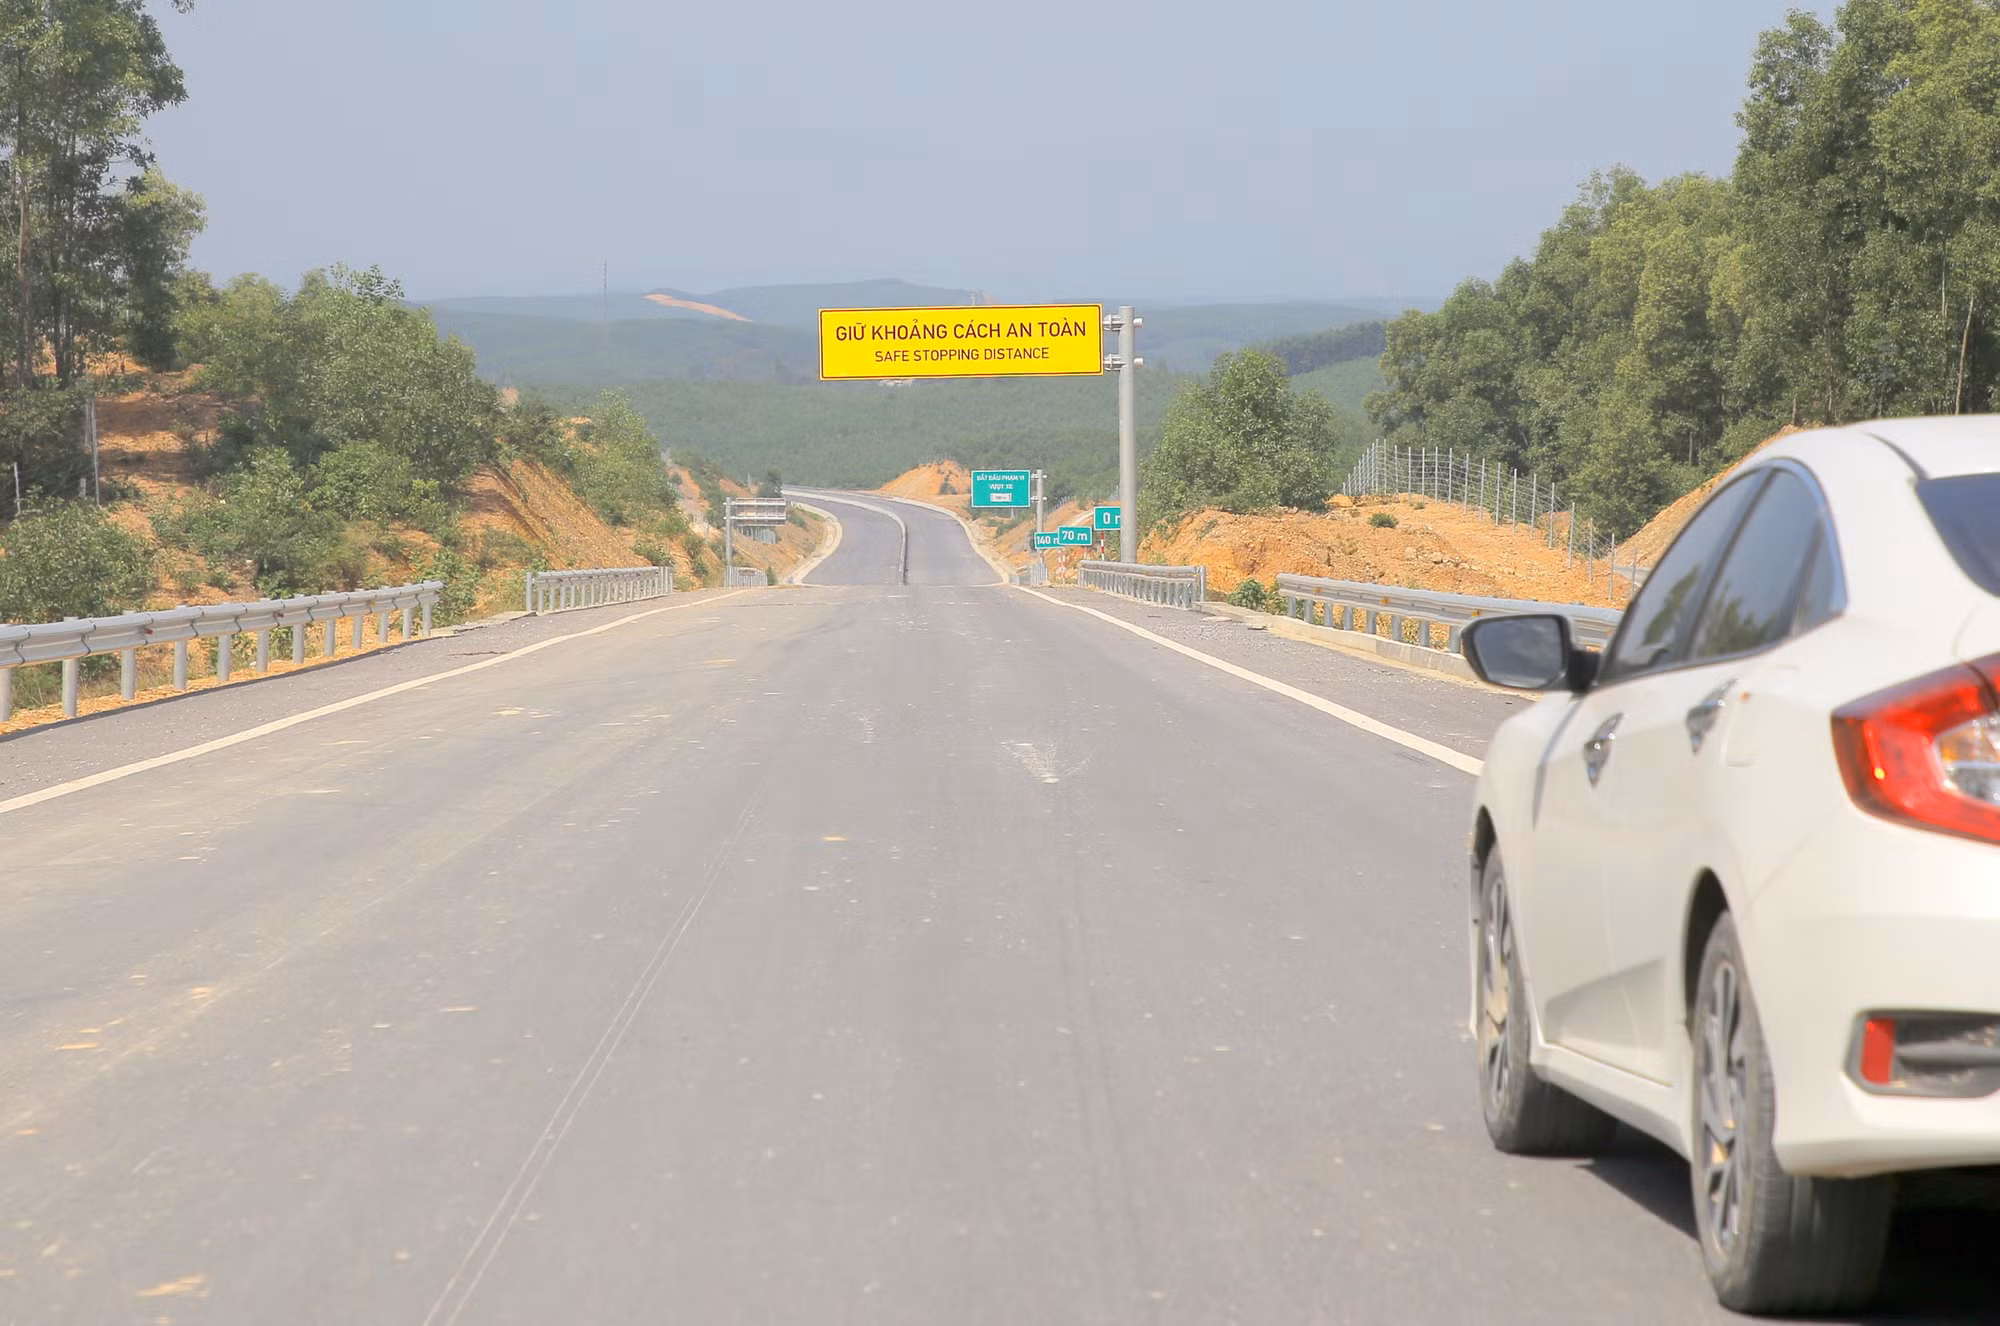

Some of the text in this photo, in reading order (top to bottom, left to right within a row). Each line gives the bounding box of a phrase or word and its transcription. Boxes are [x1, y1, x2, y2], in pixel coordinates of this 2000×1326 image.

[835, 317, 1086, 341] GIỮ KHOẢNG CÁCH AN TOÀN
[874, 347, 1050, 362] SAFE STOPPING DISTANCE
[1103, 512, 1111, 524] 0
[1036, 536, 1051, 544] 140
[1061, 530, 1088, 541] 70 m
